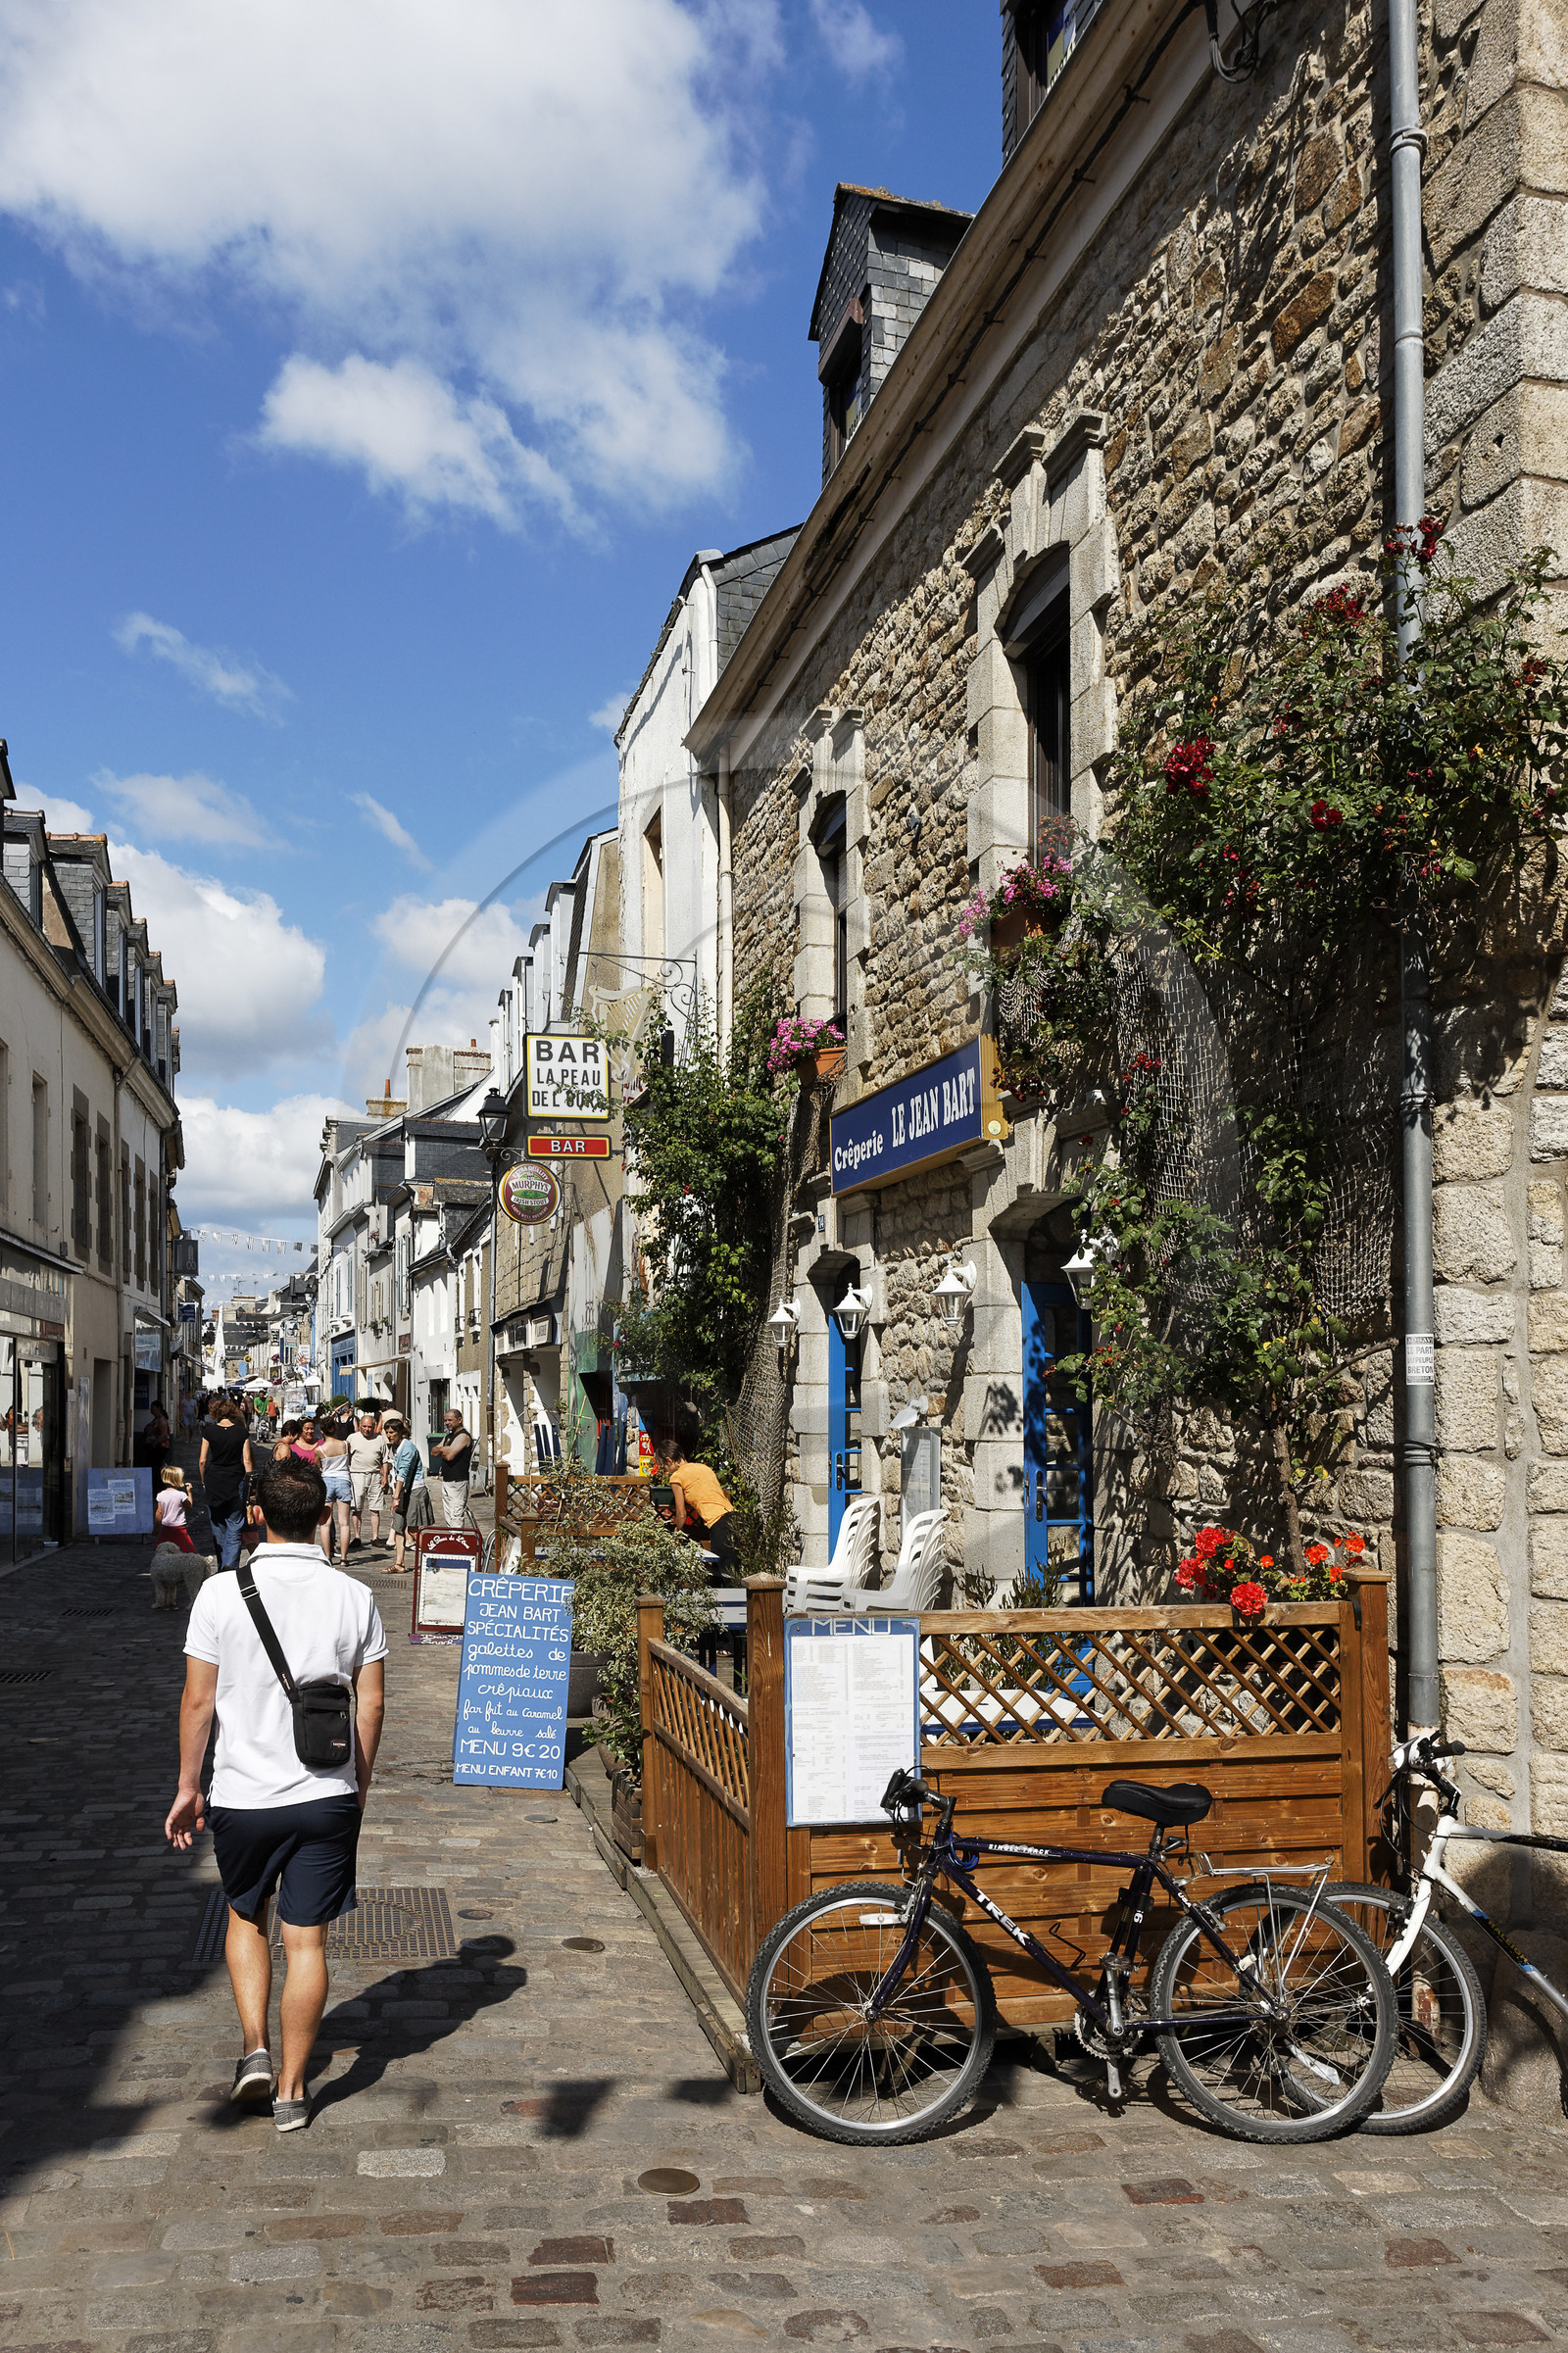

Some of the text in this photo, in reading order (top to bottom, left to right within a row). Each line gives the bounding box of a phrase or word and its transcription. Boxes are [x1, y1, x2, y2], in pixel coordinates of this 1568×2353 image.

[535, 1040, 599, 1064] BAR
[537, 1067, 601, 1087] LA PEAU
[531, 1090, 549, 1107] DE
[834, 1066, 975, 1171] Crêperie LE JEAN BART
[550, 1140, 587, 1153] BAR
[513, 1197, 529, 1205] IRISH
[467, 1576, 575, 1604] CRÊPERIE
[479, 1602, 562, 1623] JEAN BART
[466, 1619, 569, 1642] SPÉCIALITÉS
[811, 1617, 891, 1637] MENU
[467, 1642, 567, 1662] galettes de
[463, 1663, 567, 1681] pommes de terre
[477, 1682, 554, 1703] crêpiaux
[463, 1698, 564, 1722] far frit au Caramel
[490, 1720, 524, 1737] beurre
[535, 1725, 558, 1740] salé
[460, 1739, 508, 1756] MENU
[456, 1762, 487, 1775] MENU
[488, 1765, 533, 1779] ENFANT
[1022, 1846, 1052, 1855] TRACK
[1177, 1891, 1193, 1909] USA
[975, 1887, 1031, 1947] TREK
